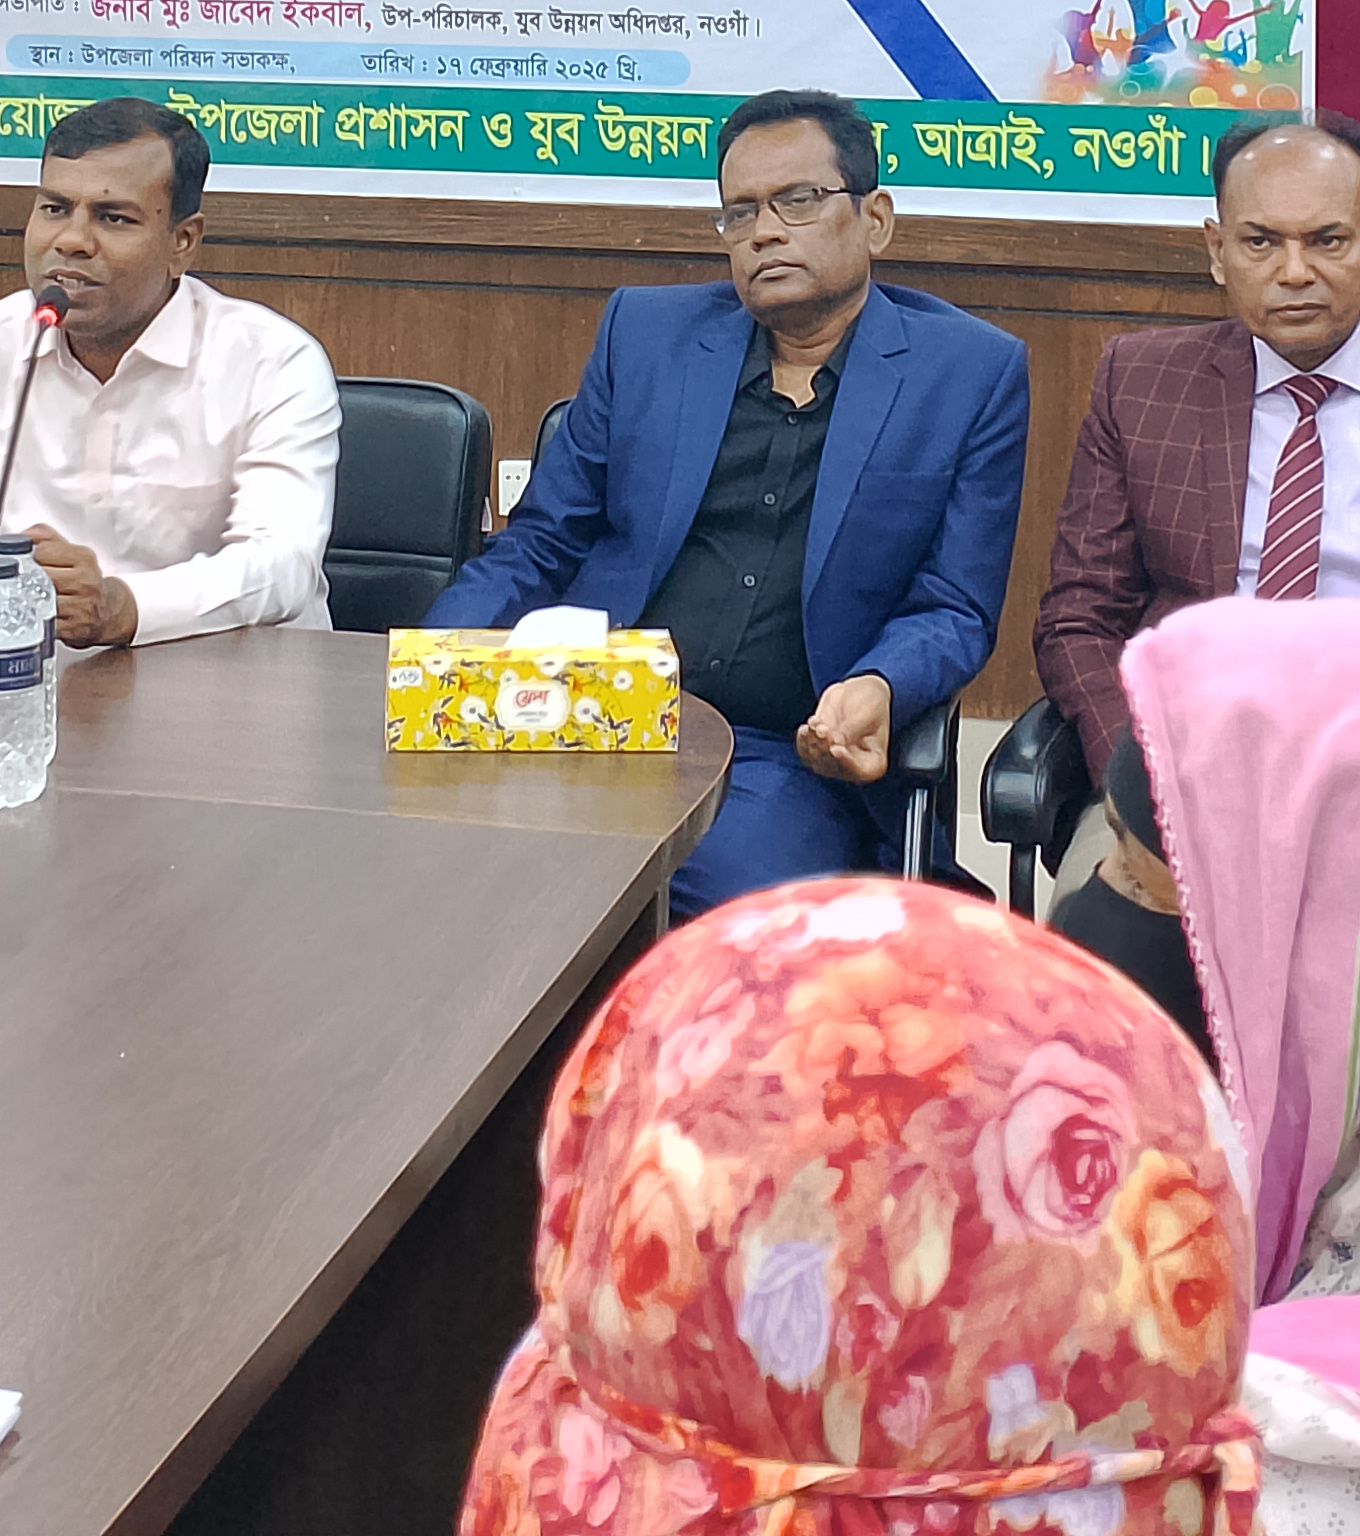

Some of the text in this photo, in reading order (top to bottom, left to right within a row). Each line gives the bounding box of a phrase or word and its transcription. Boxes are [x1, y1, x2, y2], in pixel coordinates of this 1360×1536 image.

[515, 12, 543, 36] যুব
[28, 46, 62, 66] স্থান
[81, 43, 153, 66] উপজেলা
[160, 44, 216, 68] পরিষদ
[360, 49, 414, 73] তারিখ
[438, 57, 461, 75] ১৭
[556, 60, 608, 80] ২০২৫
[336, 103, 470, 151] প্রশাসন
[482, 113, 511, 147] ও
[525, 112, 585, 165] যুব
